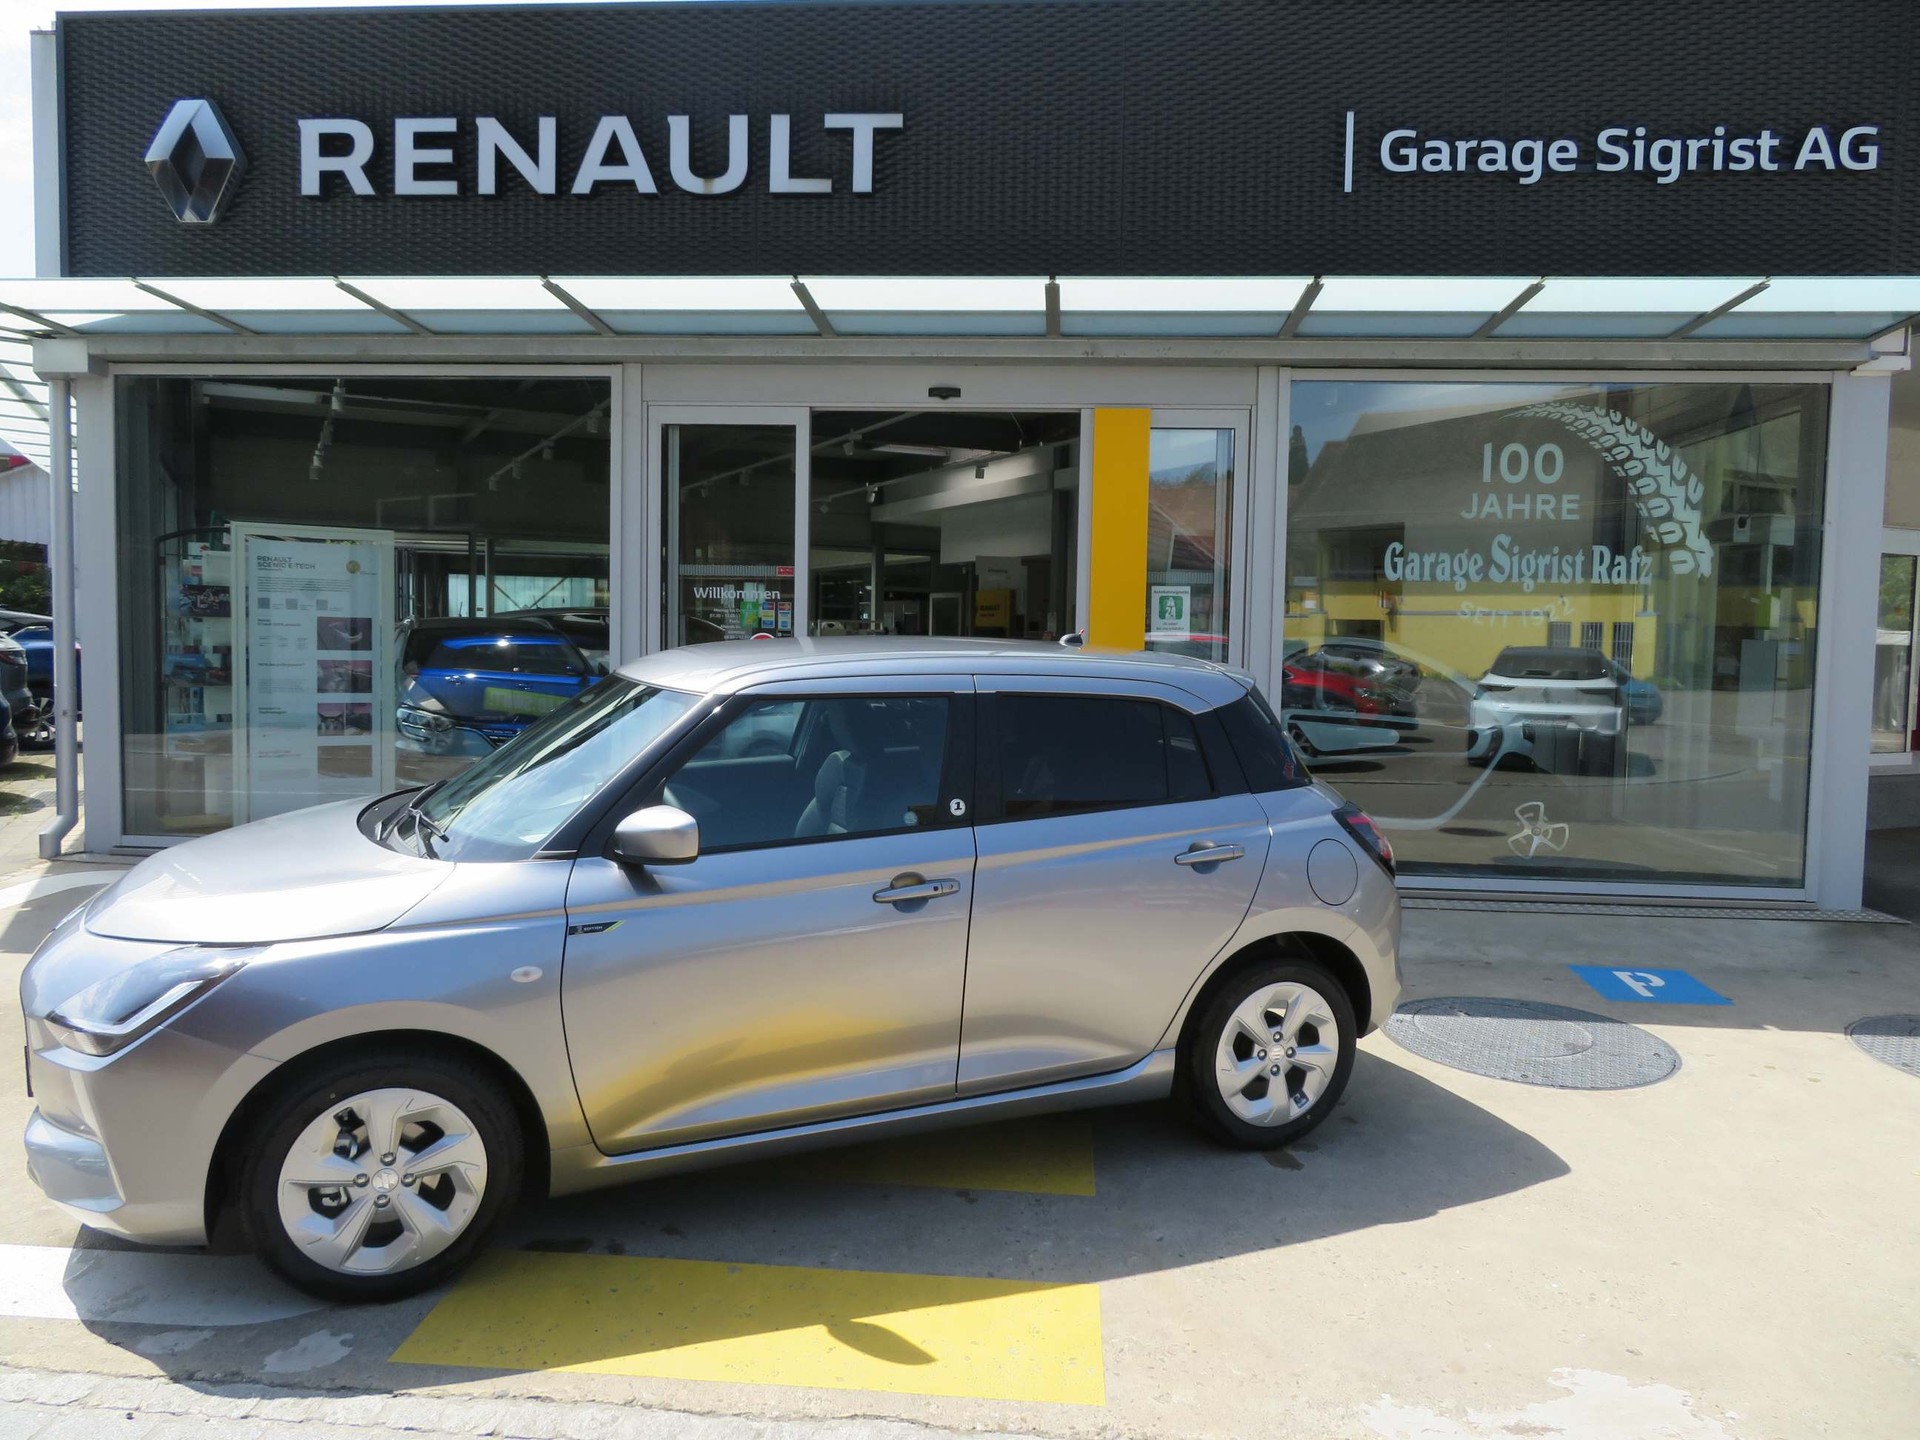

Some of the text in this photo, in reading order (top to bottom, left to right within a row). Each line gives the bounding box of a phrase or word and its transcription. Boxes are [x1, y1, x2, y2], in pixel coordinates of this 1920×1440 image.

[298, 113, 904, 197] RENAULT
[1380, 126, 1879, 184] Garage Sigrist AG
[1482, 442, 1564, 485] 100
[1460, 493, 1580, 521] JAHRE
[257, 555, 292, 563] RENAULT
[1384, 534, 1653, 592] Garage Sigrist Rafz
[694, 587, 780, 600] Willkommen
[1458, 601, 1513, 628] SEIT
[1612, 971, 1665, 998] P
